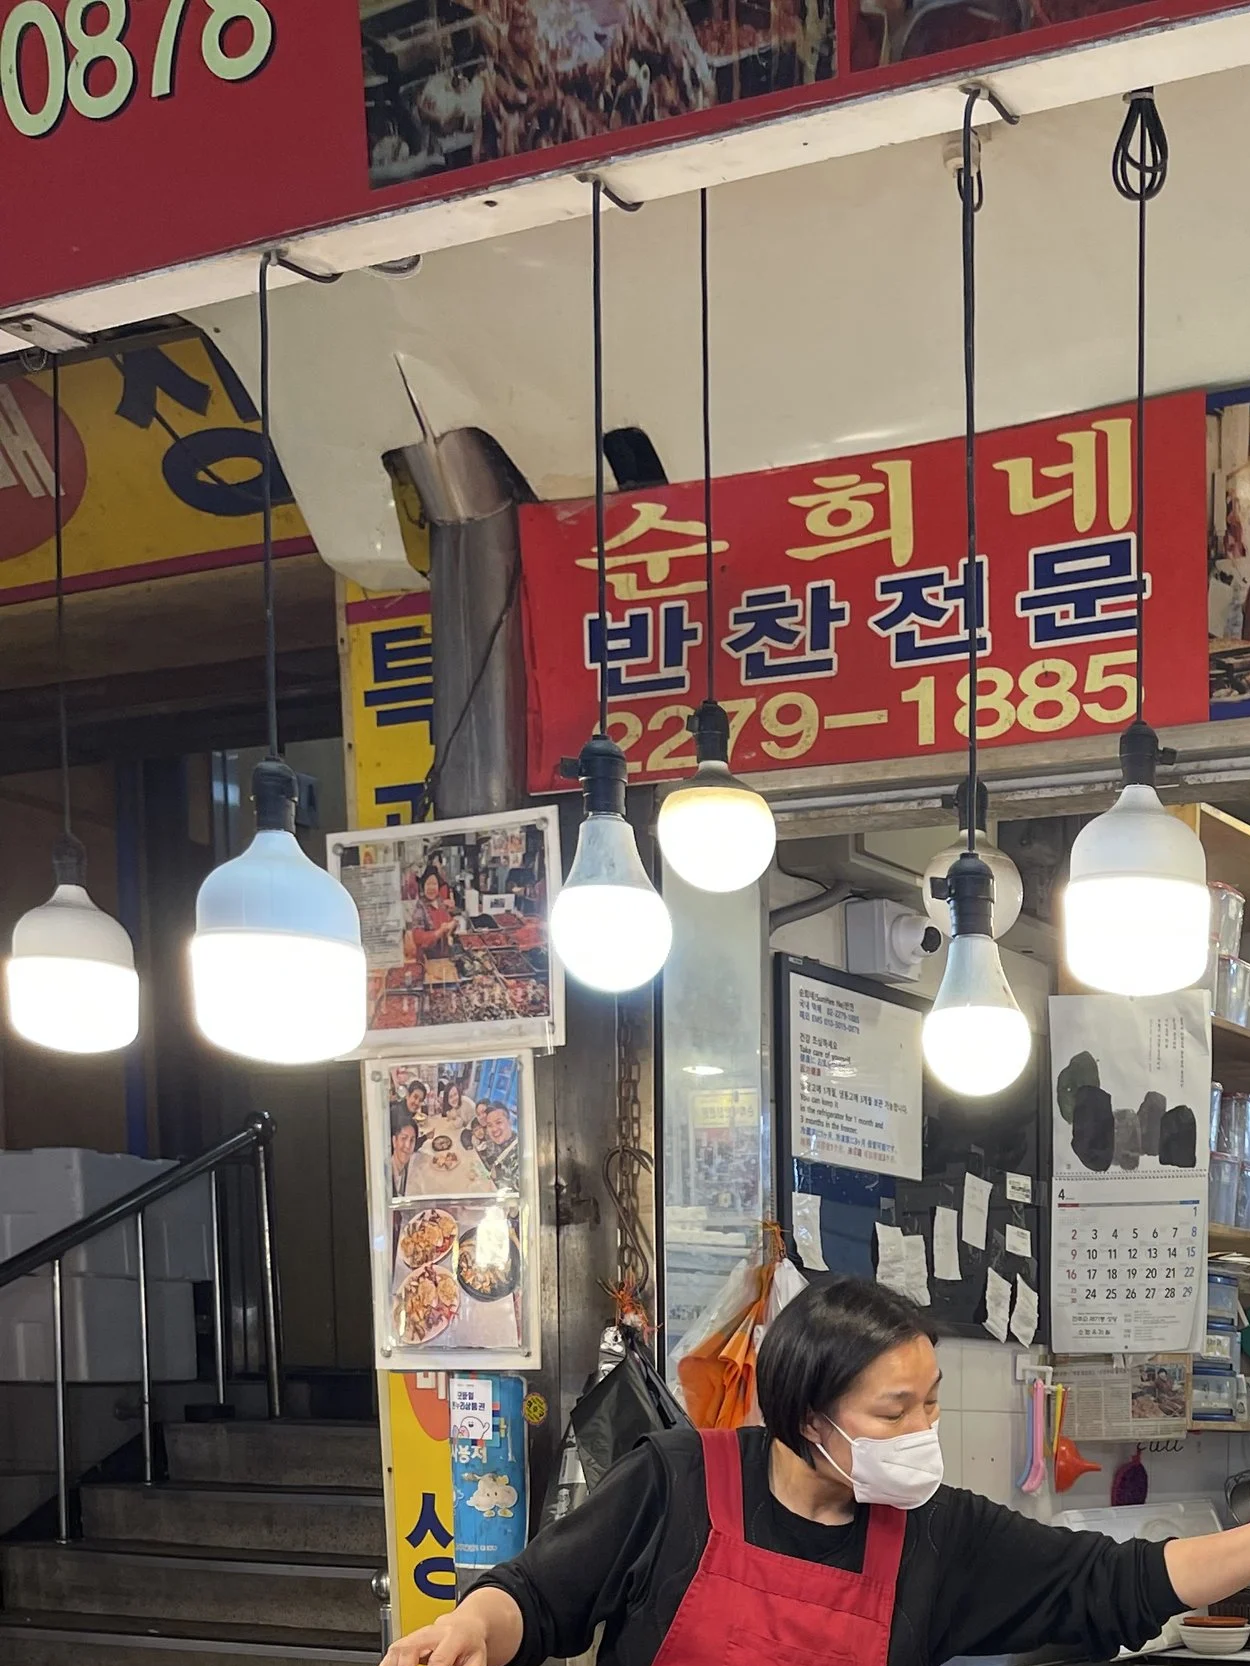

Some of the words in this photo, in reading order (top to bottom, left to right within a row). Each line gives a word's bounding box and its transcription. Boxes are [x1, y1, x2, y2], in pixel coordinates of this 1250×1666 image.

[584, 532, 1151, 702] 반찬전문
[592, 649, 1145, 773] 2279-1885
[1058, 1188, 1066, 1201] 4
[1192, 1206, 1198, 1217] 1
[1071, 1229, 1078, 1241] 2
[1091, 1229, 1098, 1240] 3
[1111, 1229, 1119, 1240] 4
[1132, 1228, 1139, 1239] 5
[1152, 1227, 1159, 1239] 6
[1172, 1227, 1178, 1239] 7
[1191, 1226, 1197, 1237] 8
[1070, 1249, 1077, 1260] 9
[1086, 1249, 1098, 1260] 10
[1107, 1249, 1117, 1260] 11
[1127, 1249, 1138, 1260] 12
[1147, 1248, 1158, 1259] 13
[1167, 1247, 1177, 1258] 14
[1186, 1246, 1196, 1257] 15
[1066, 1269, 1077, 1280] 16
[1086, 1269, 1097, 1280] 17
[1107, 1269, 1118, 1280] 18
[1127, 1269, 1137, 1280] 19
[1145, 1268, 1157, 1279] 20
[1165, 1267, 1176, 1279] 21
[1184, 1266, 1195, 1278] 22
[1085, 1288, 1097, 1300] 24
[1105, 1288, 1117, 1300] 25
[1125, 1288, 1137, 1299] 26
[1145, 1288, 1156, 1299] 27
[1164, 1287, 1176, 1299] 28
[1182, 1286, 1193, 1298] 29
